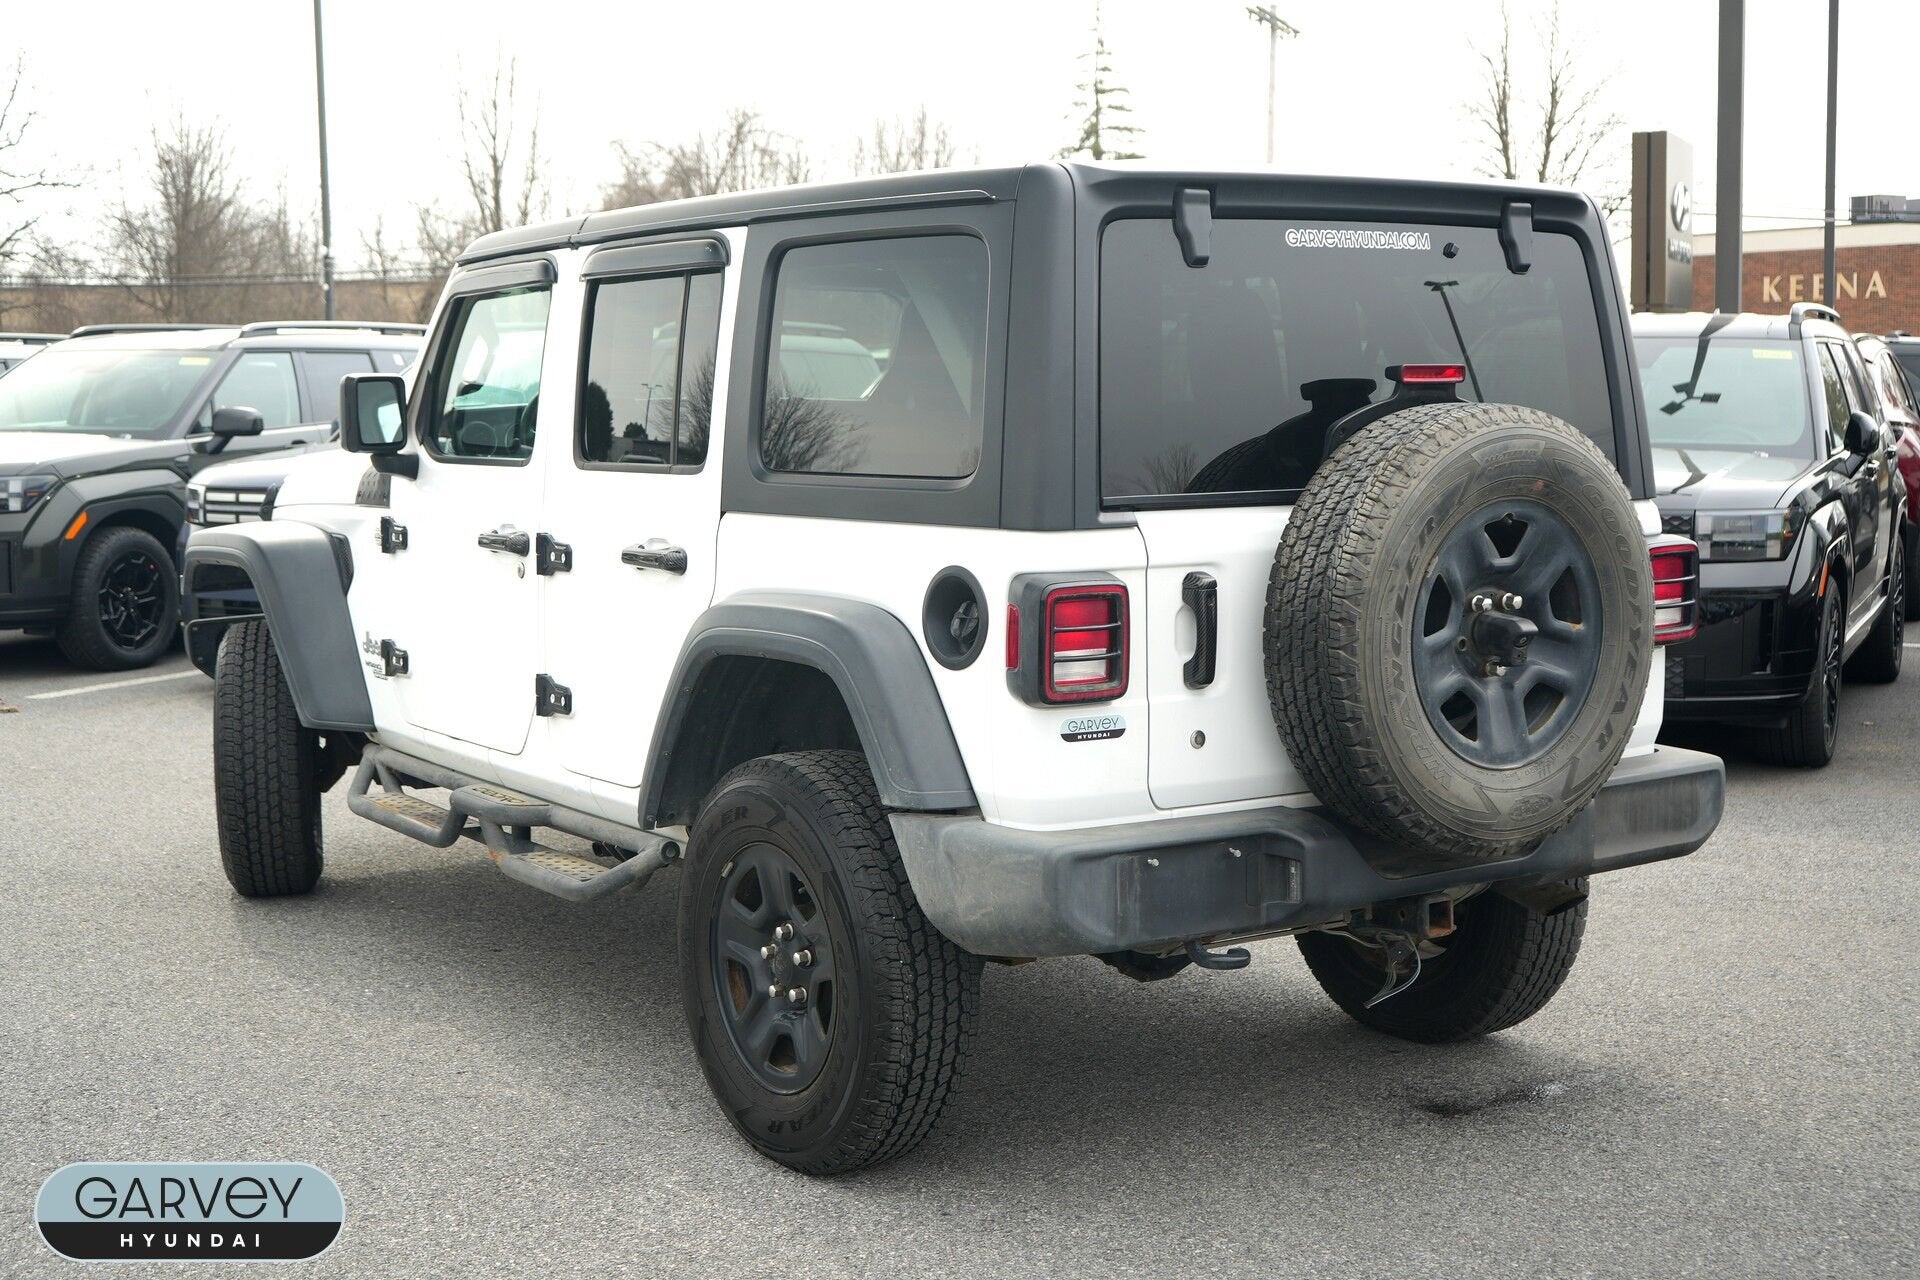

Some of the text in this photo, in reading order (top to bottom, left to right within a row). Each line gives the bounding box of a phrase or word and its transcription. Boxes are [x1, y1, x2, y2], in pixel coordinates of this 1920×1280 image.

[1763, 270, 1887, 303] KEENA
[1582, 483, 1643, 751] GOODYEAR
[1077, 732, 1111, 740] HYUNDAI
